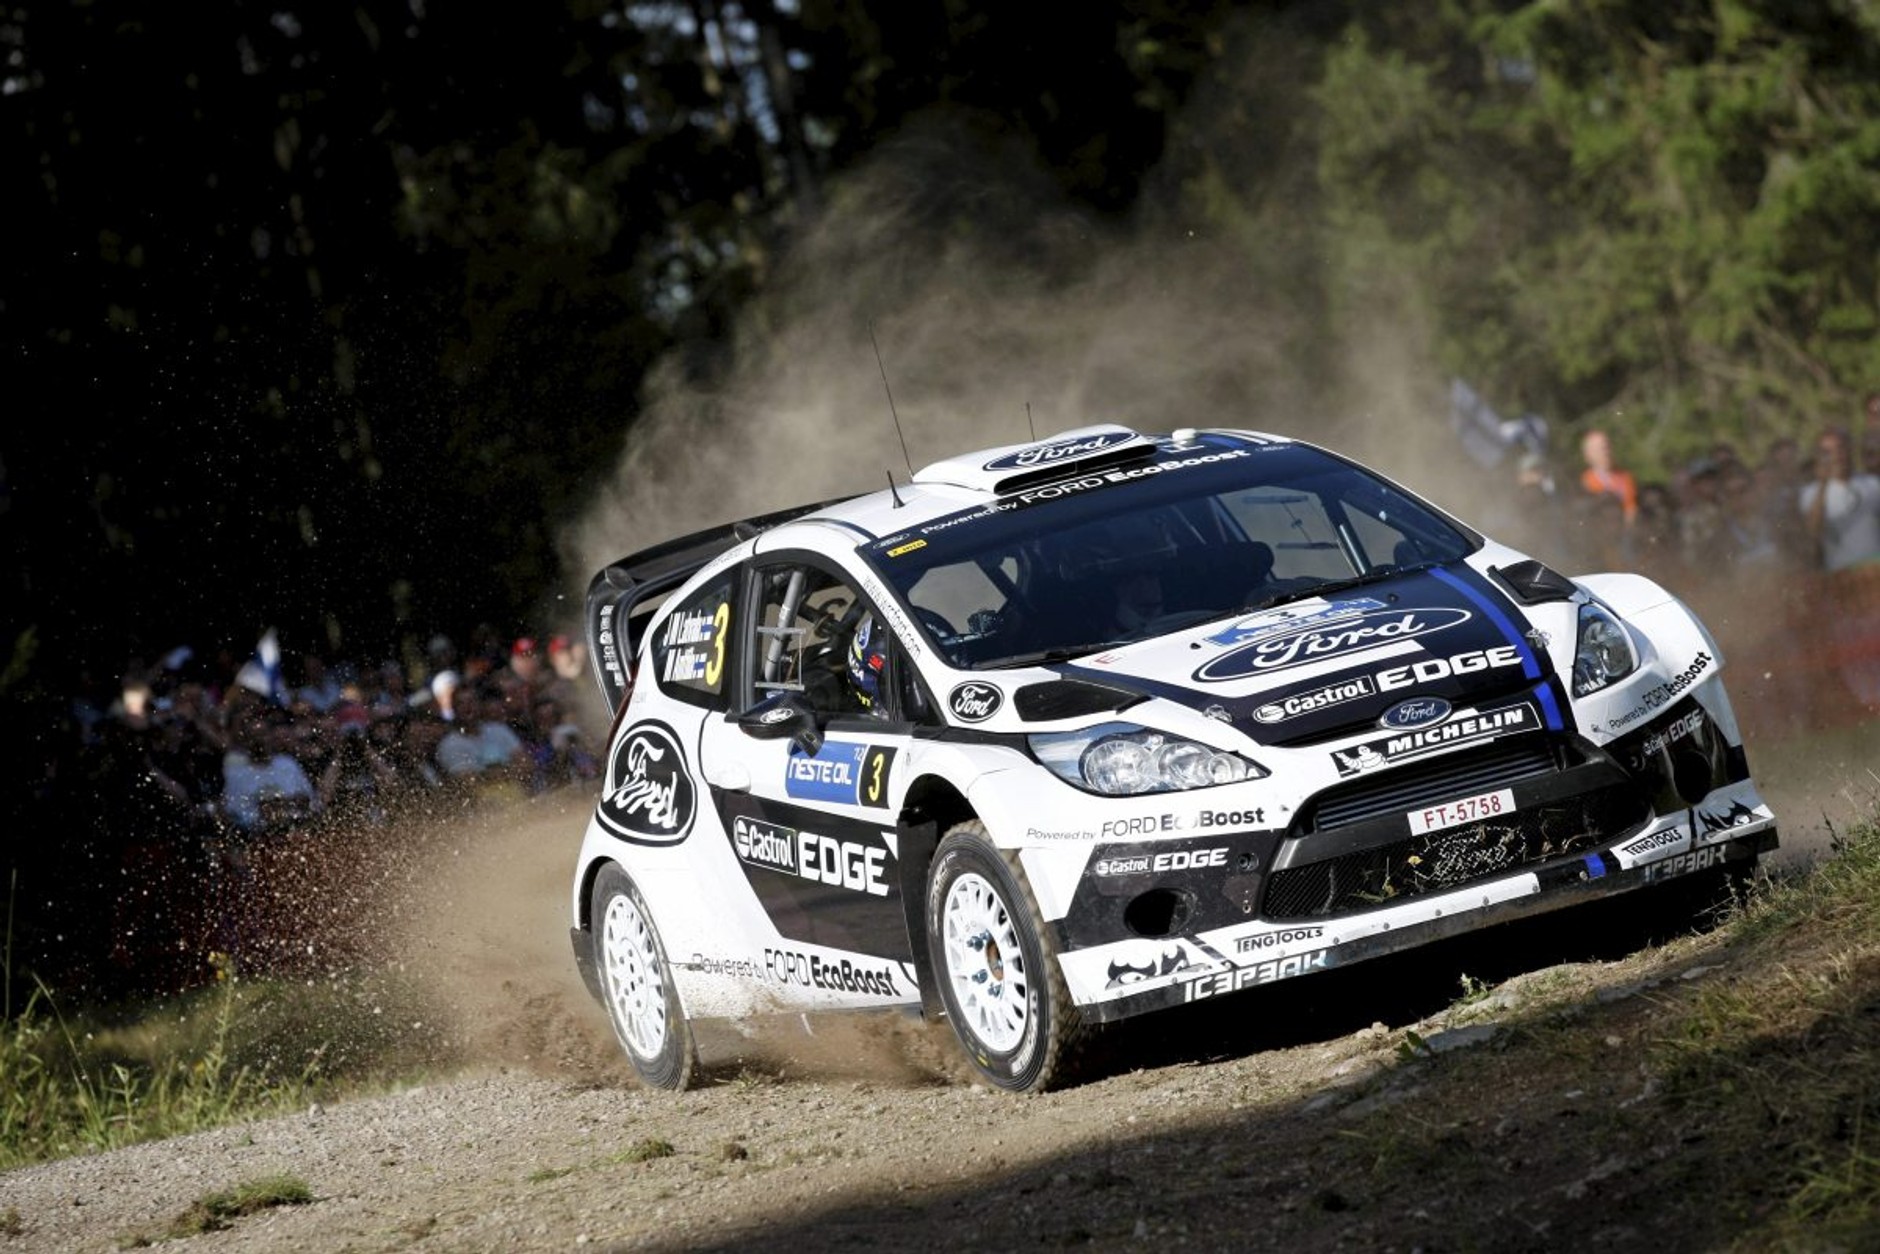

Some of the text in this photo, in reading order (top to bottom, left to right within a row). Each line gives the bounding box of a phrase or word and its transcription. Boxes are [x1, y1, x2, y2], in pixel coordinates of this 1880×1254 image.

[1016, 436, 1111, 465] Ford
[920, 505, 998, 534] Powered
[1020, 477, 1104, 503] FORD
[1103, 449, 1251, 483] EcoBoost
[706, 602, 729, 686] 3
[1252, 614, 1424, 668] Ford
[955, 685, 994, 716] Ford
[1285, 645, 1523, 715] Castrol EDGE
[1609, 709, 1640, 729] Powered
[1642, 683, 1671, 709] FORD
[1665, 651, 1711, 697] EcoBoost
[1388, 709, 1523, 755] MICHELIN
[1400, 701, 1436, 722] Ford
[1669, 709, 1703, 741] EDGE
[612, 736, 678, 829] Ford
[868, 753, 884, 801] 3
[1026, 827, 1080, 840] Powered
[1102, 816, 1156, 838] FORD
[1424, 794, 1502, 829] FT-5758
[749, 828, 794, 868] Castrol
[799, 831, 889, 896] EDGE
[1110, 848, 1229, 873] Castrol EDGE
[692, 953, 750, 978] Powered
[764, 948, 810, 986] FORD
[810, 955, 901, 997] EcoBoost
